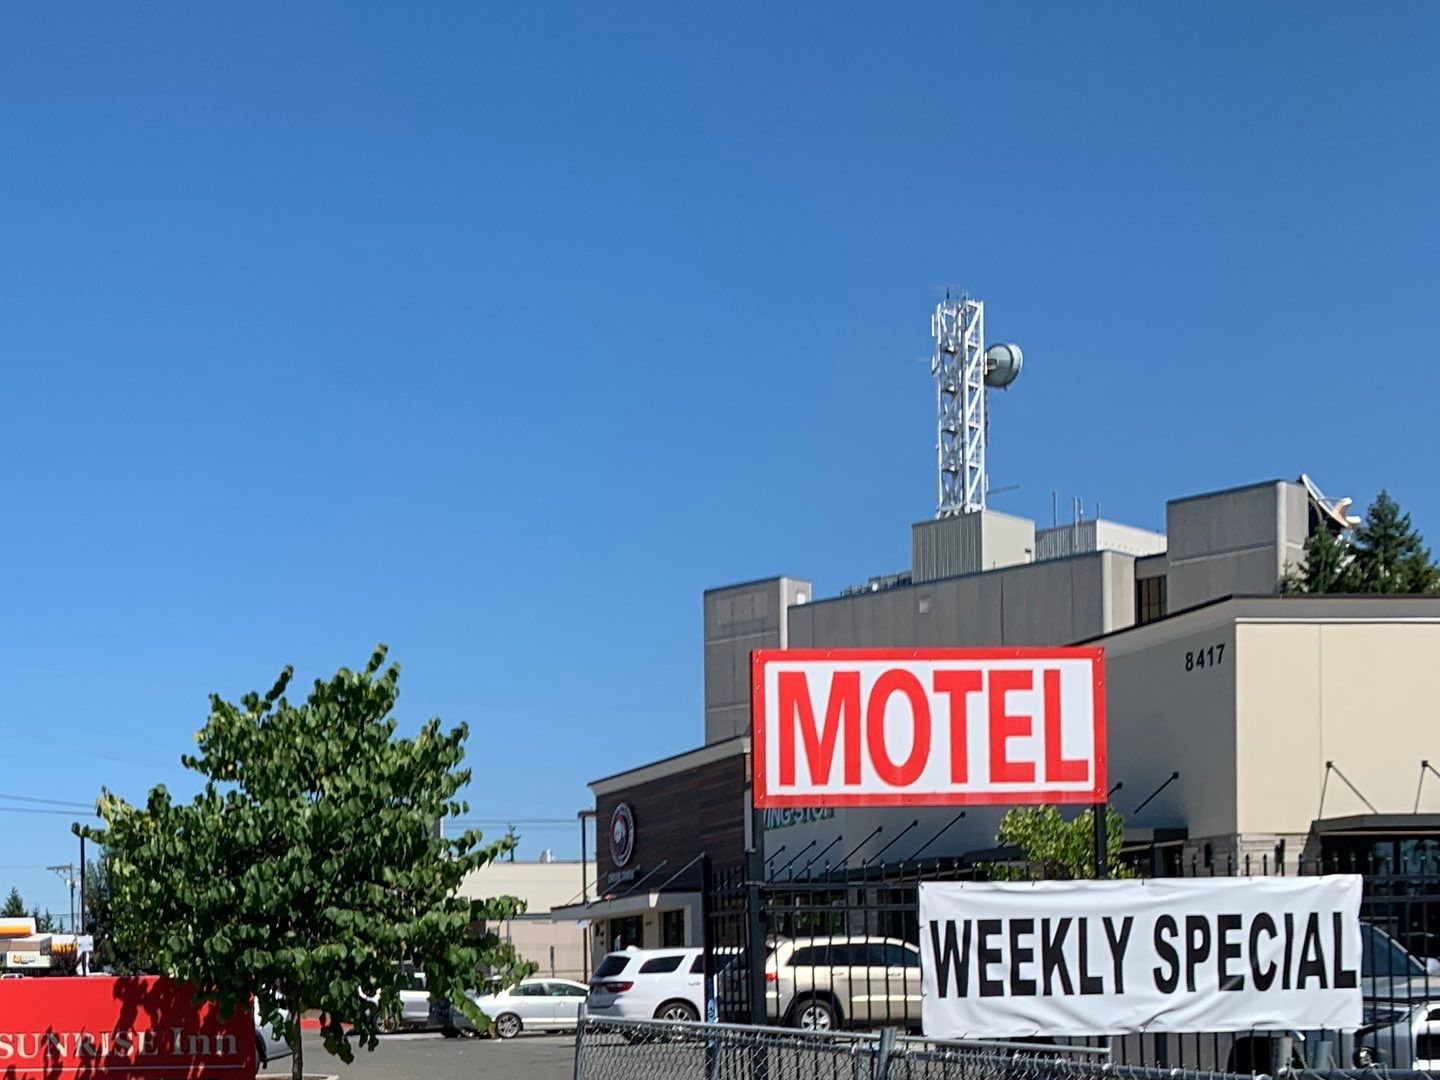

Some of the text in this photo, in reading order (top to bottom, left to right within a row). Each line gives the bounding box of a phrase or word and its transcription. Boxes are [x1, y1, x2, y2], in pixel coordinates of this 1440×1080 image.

[1185, 643, 1226, 672] 8417
[777, 668, 1089, 787] MOTEL
[929, 911, 1358, 999] WEEKLY SPECIAL
[170, 1026, 239, 1057] Inn
